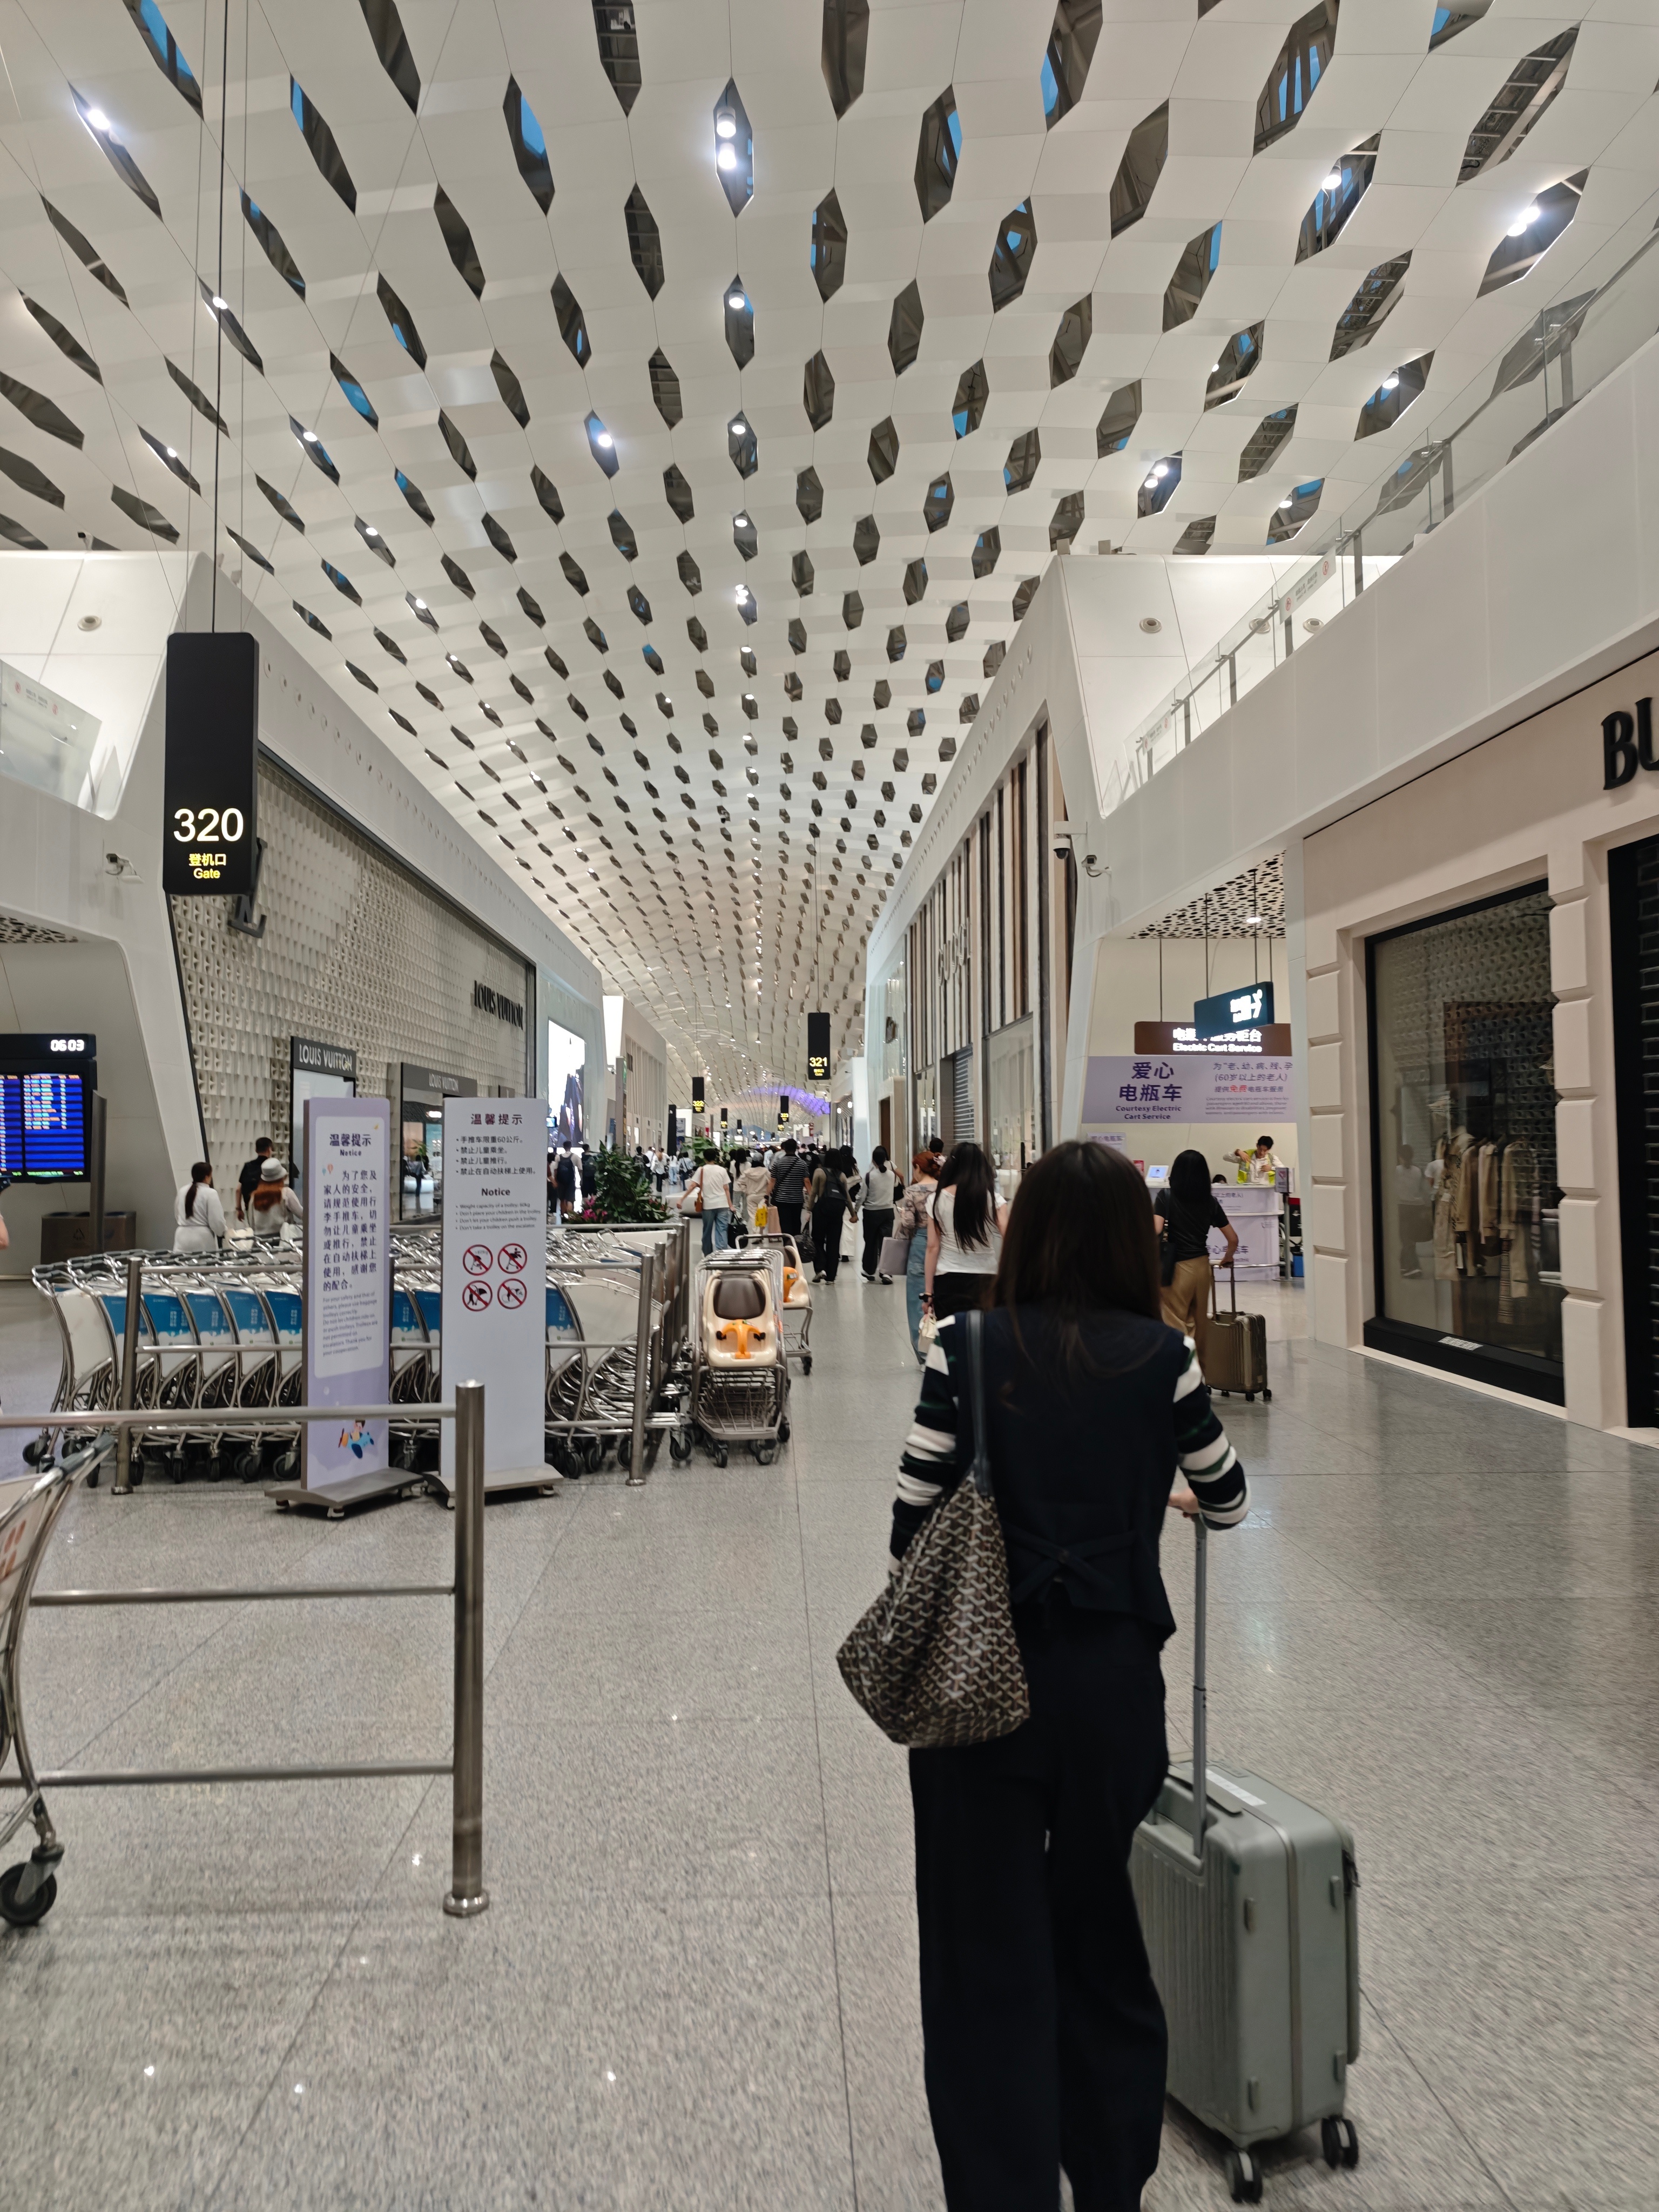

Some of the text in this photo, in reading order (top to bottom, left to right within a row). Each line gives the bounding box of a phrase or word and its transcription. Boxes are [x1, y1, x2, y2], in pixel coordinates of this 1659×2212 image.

[173, 808, 244, 842] 320
[188, 853, 226, 866] 登机口
[193, 868, 220, 879] Gate
[474, 980, 495, 1015] LOUIS
[299, 1043, 353, 1072] LOUIS VUITTON
[810, 1057, 827, 1067] 321
[1131, 1062, 1174, 1079] 爱心
[1119, 1084, 1183, 1102] 电瓶车
[471, 1114, 523, 1125] 温馨提示
[329, 1133, 372, 1147] 温馨提示
[342, 1170, 377, 1181] 为了您及
[481, 1188, 510, 1196] Notice
[324, 1196, 376, 1209] 请规范使用行
[323, 1249, 376, 1264] 在自动扶梯上
[323, 1278, 352, 1291] 的配合。
